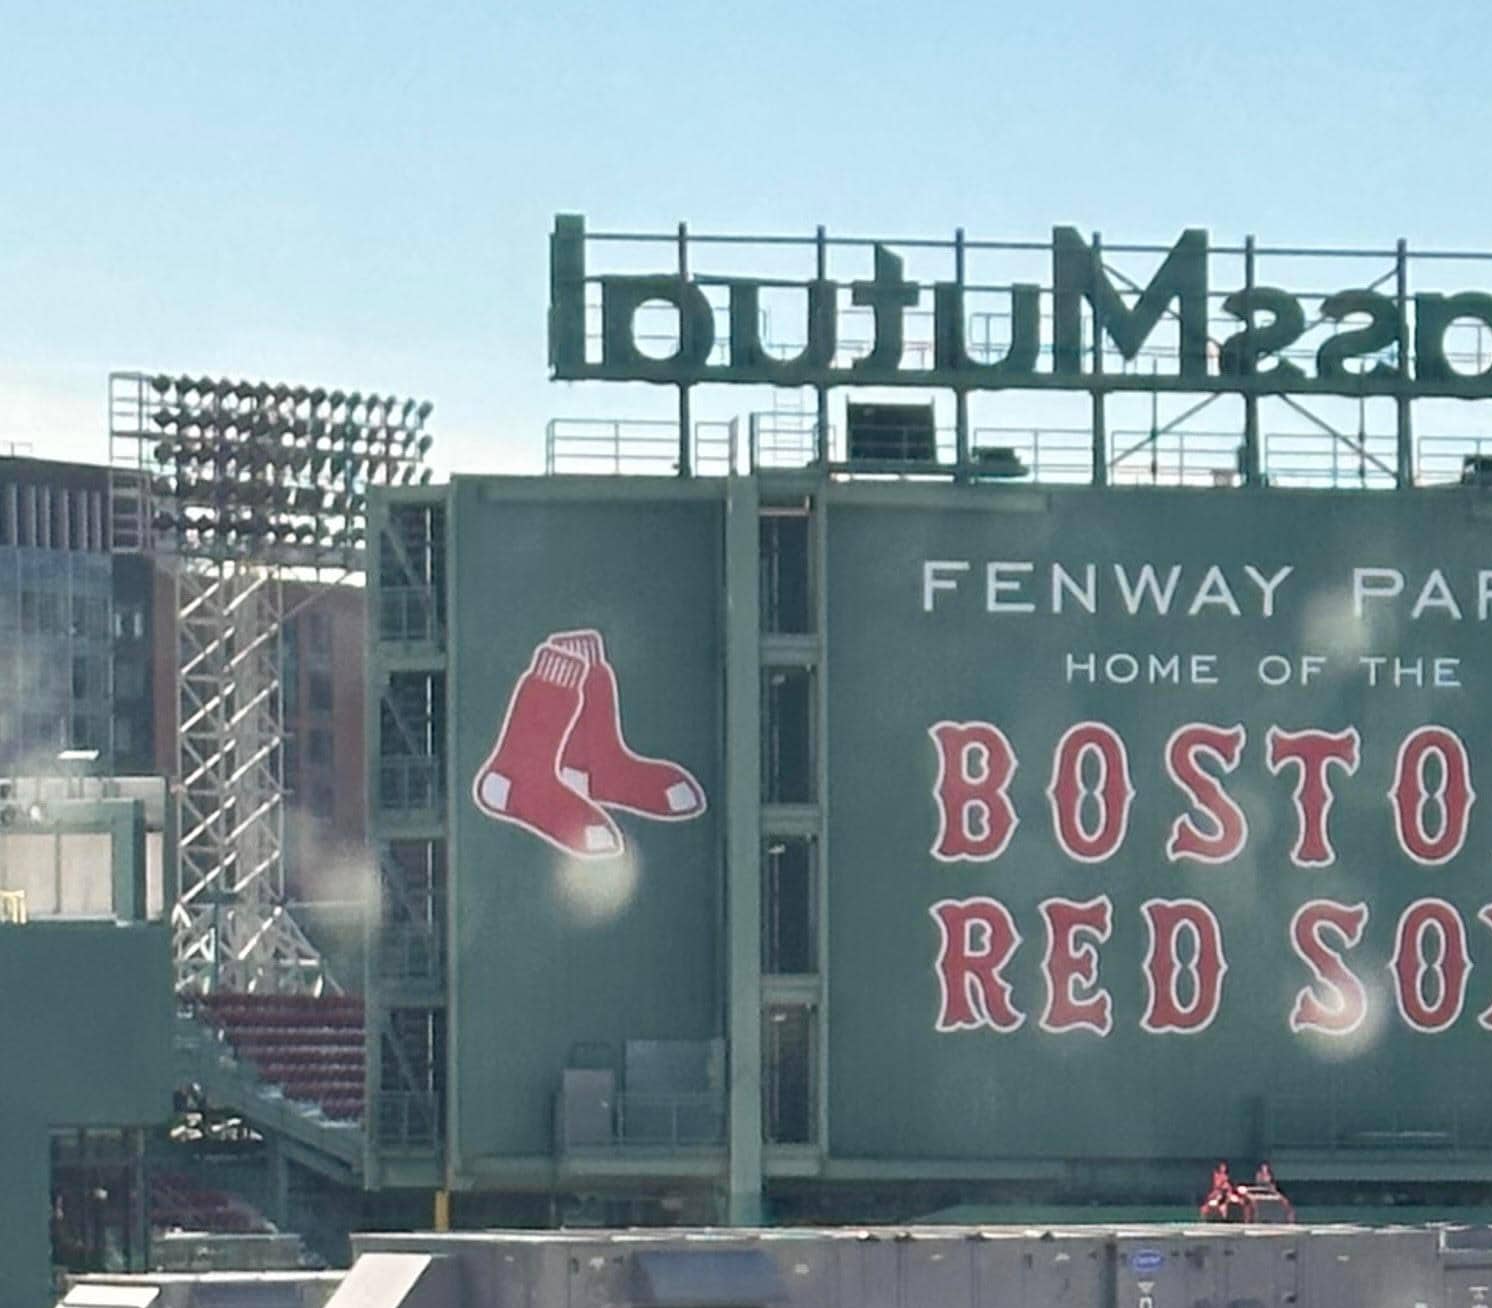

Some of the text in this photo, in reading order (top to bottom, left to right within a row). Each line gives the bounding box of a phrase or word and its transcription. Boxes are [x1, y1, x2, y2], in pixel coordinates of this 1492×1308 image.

[922, 560, 1293, 617] FENWAY
[1066, 653, 1461, 687] HOME OF THE
[929, 895, 1227, 1036] RED
